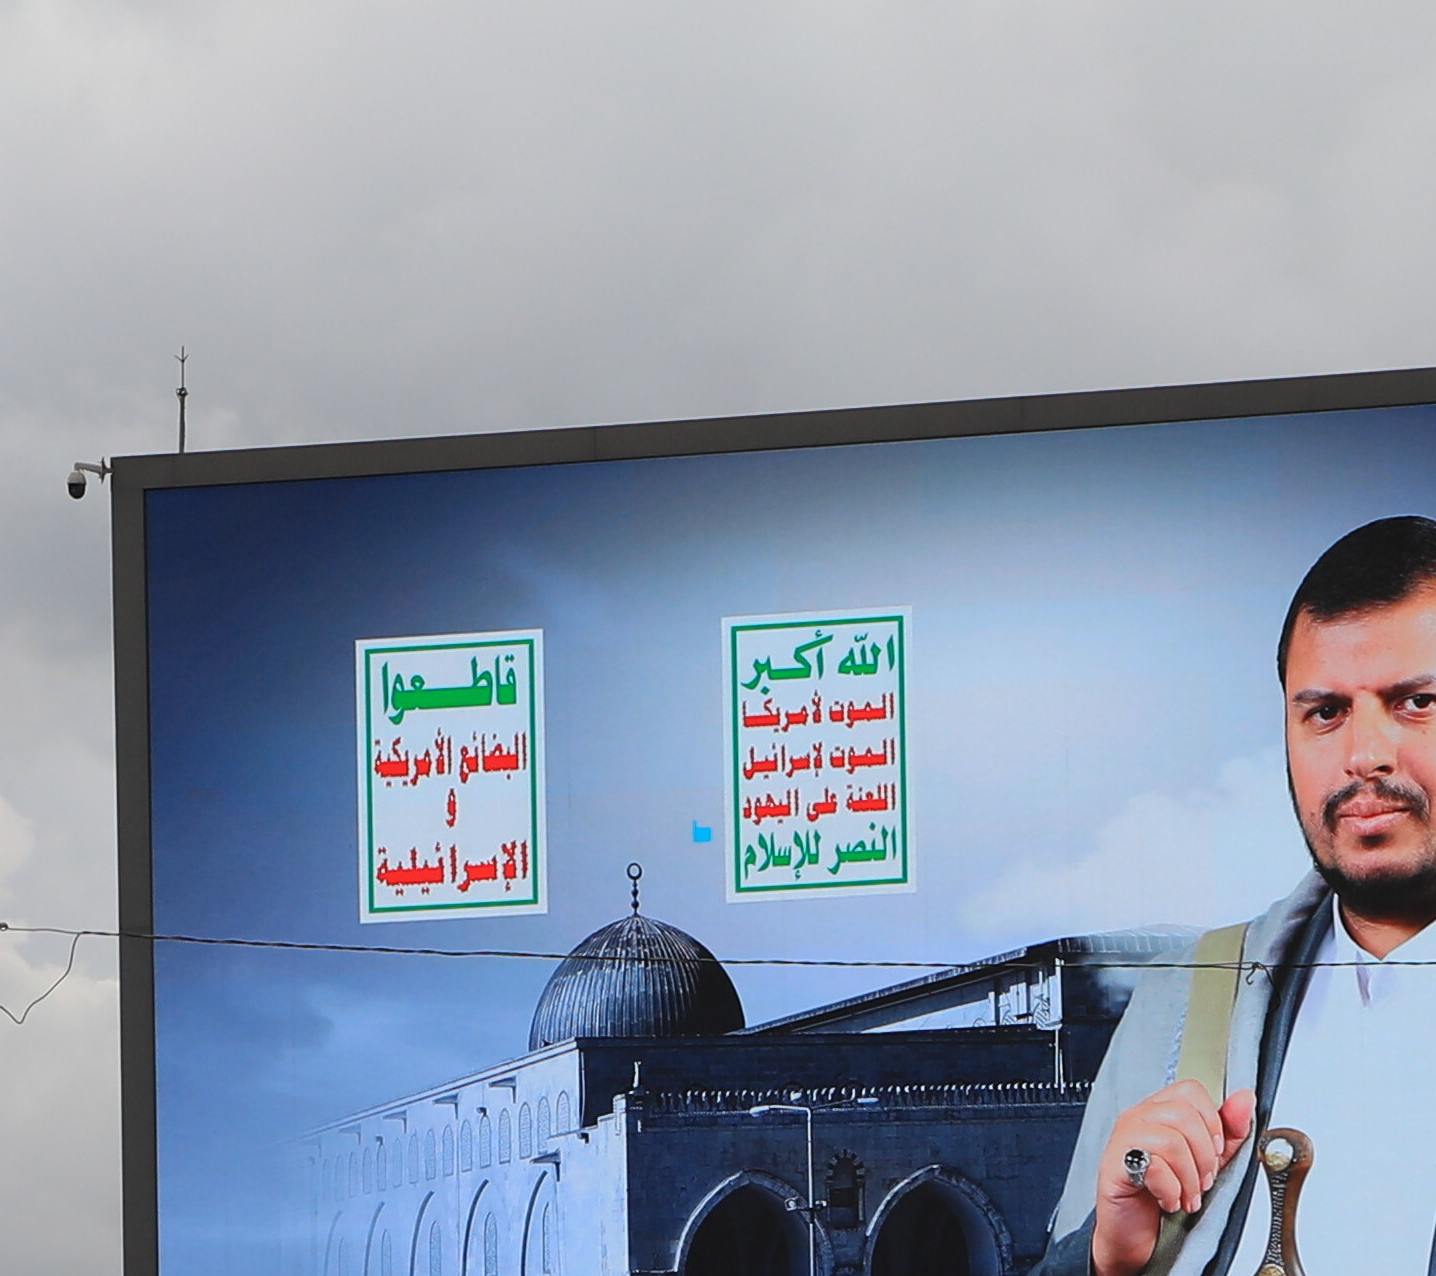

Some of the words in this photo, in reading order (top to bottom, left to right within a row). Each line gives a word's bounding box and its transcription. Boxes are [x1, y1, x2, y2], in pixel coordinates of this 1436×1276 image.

[740, 629, 833, 695] أكبر
[380, 654, 517, 725] قاطعوا
[741, 689, 822, 733] لأمريكا
[828, 691, 894, 729] الموت
[373, 728, 452, 788] الأمريكية
[458, 731, 527, 784] البضائع
[742, 741, 823, 780] لإسرائيل
[829, 738, 895, 775] الموت
[445, 788, 458, 828] و
[742, 787, 800, 825] اليهود
[806, 786, 838, 822] على
[845, 783, 896, 814] اللعنة
[375, 839, 529, 896] الإسرائيلية
[743, 829, 823, 882] للإسلام
[826, 821, 897, 876] النصر
